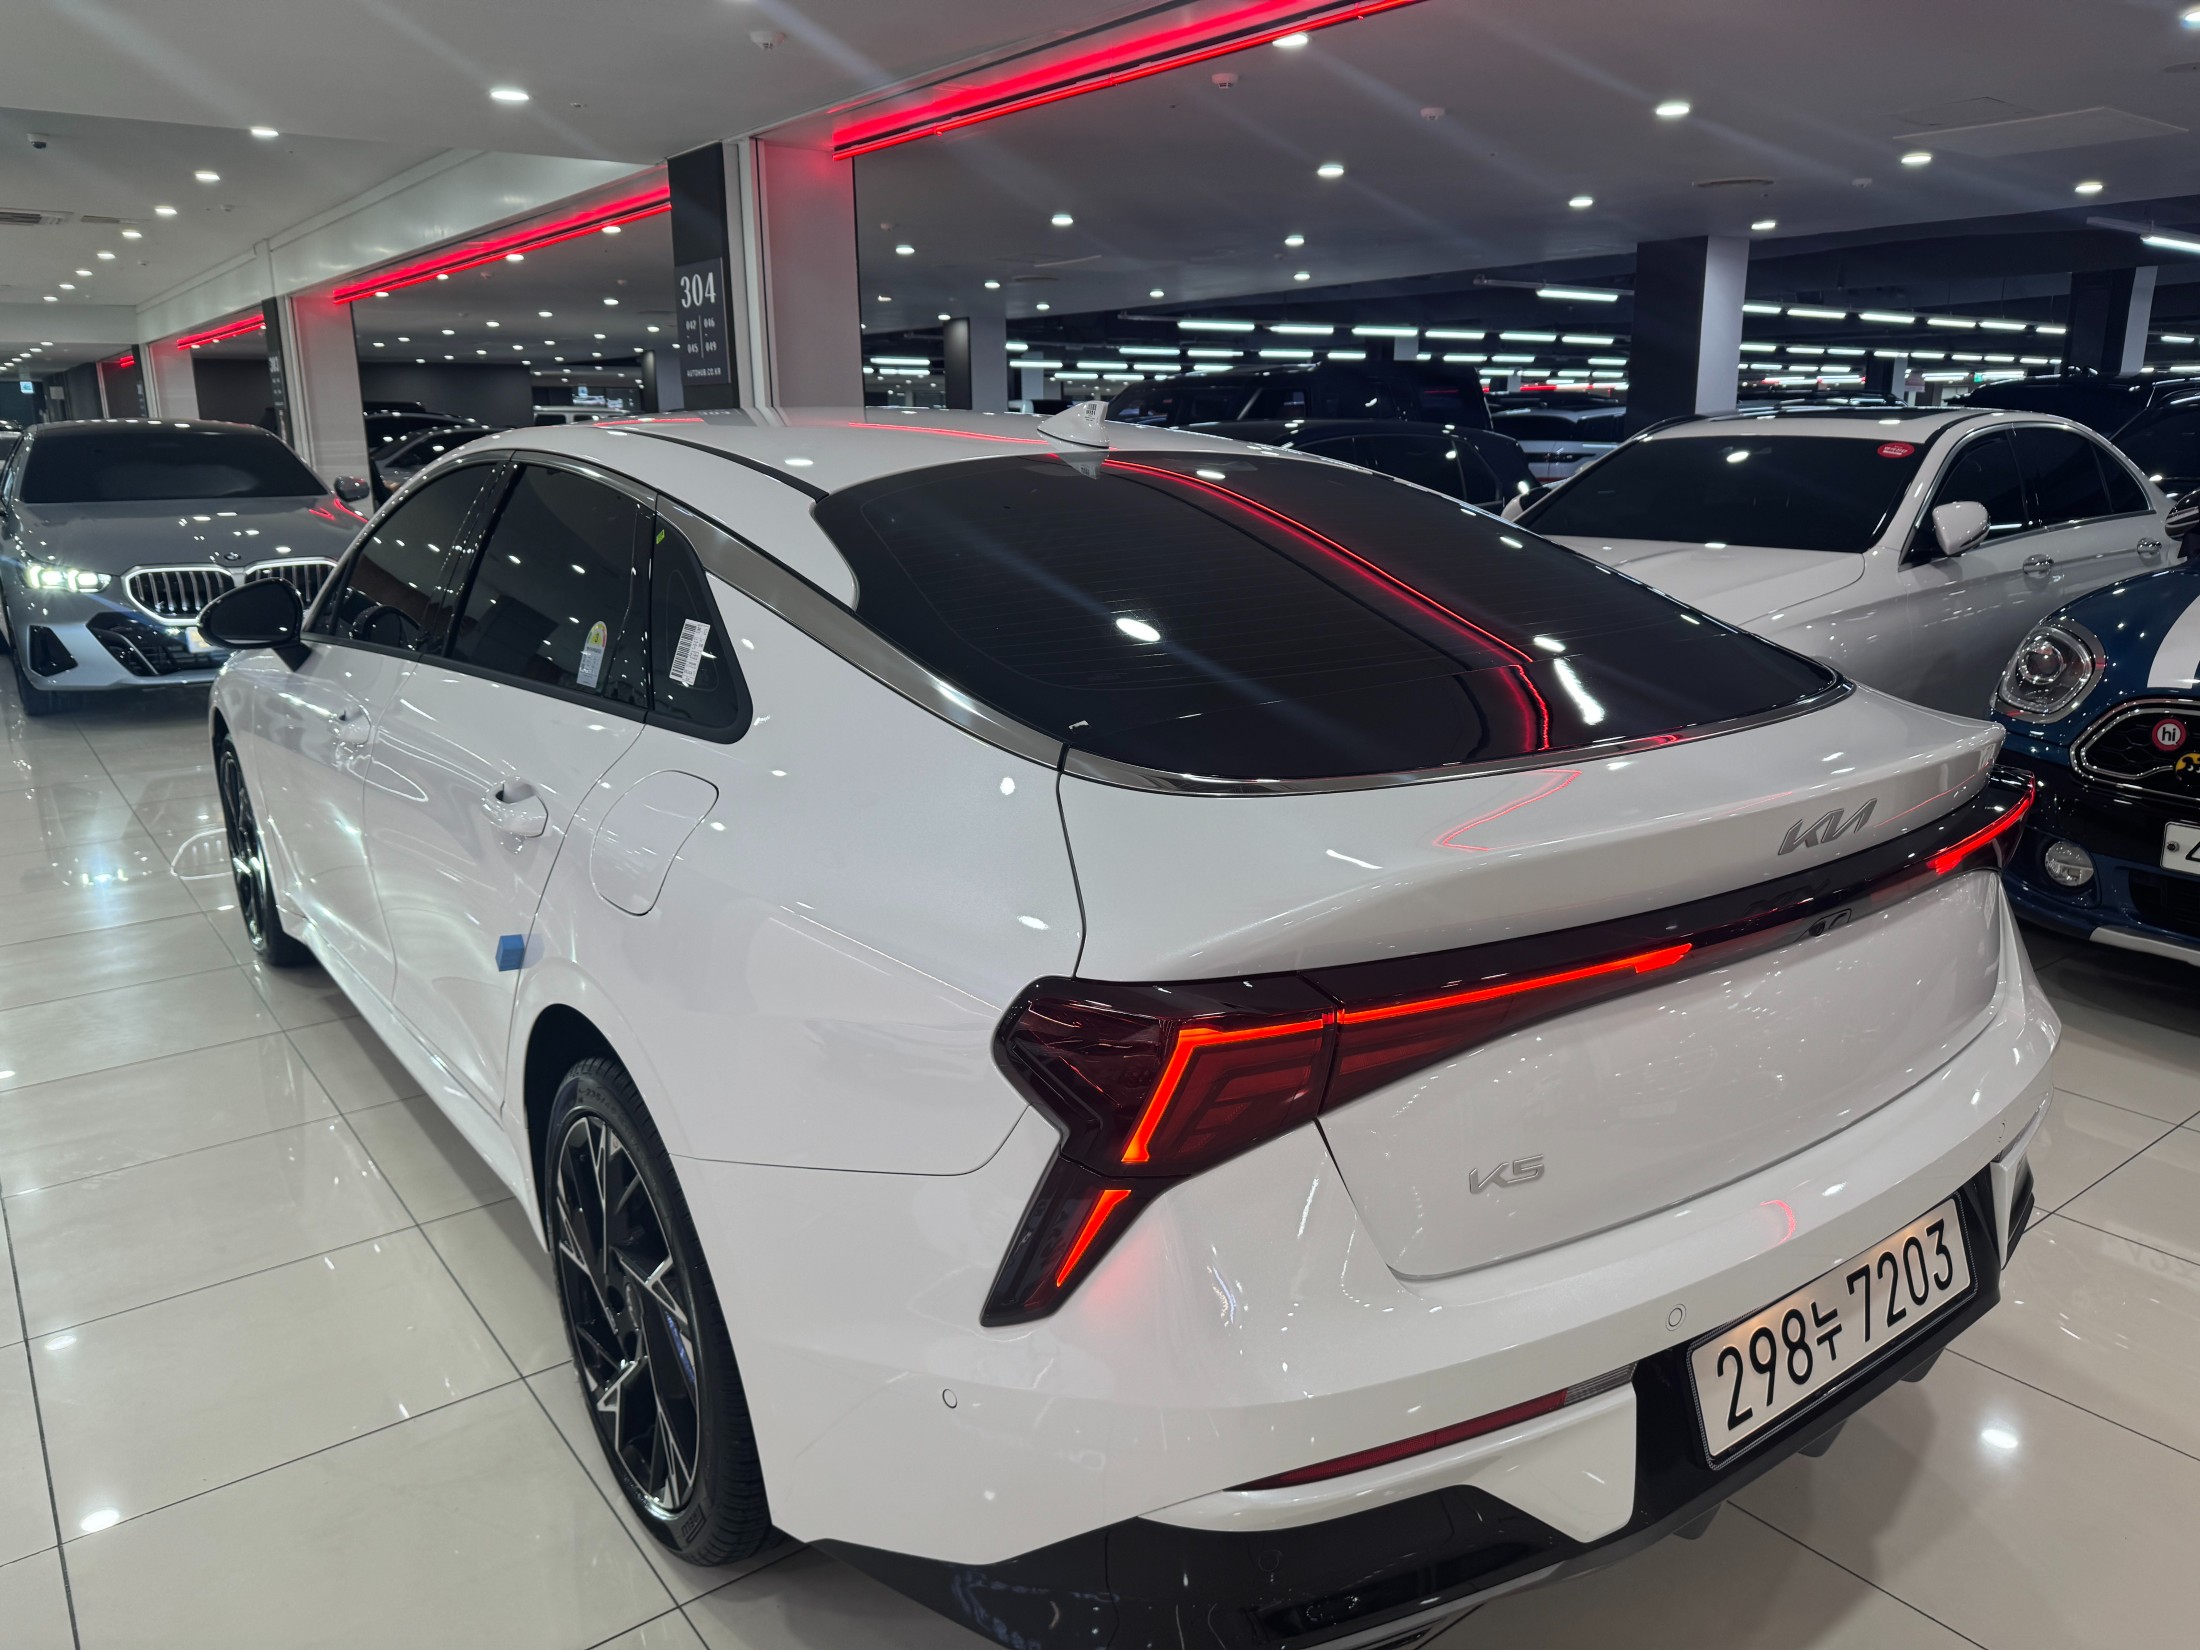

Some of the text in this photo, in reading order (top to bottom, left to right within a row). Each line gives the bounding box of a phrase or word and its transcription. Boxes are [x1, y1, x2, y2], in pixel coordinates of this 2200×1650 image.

[680, 272, 716, 308] 304
[2161, 726, 2176, 742] hi
[1778, 798, 1878, 856] KIA
[1468, 1154, 1545, 1195] K5
[1716, 1218, 1954, 1431] 298누 7203
